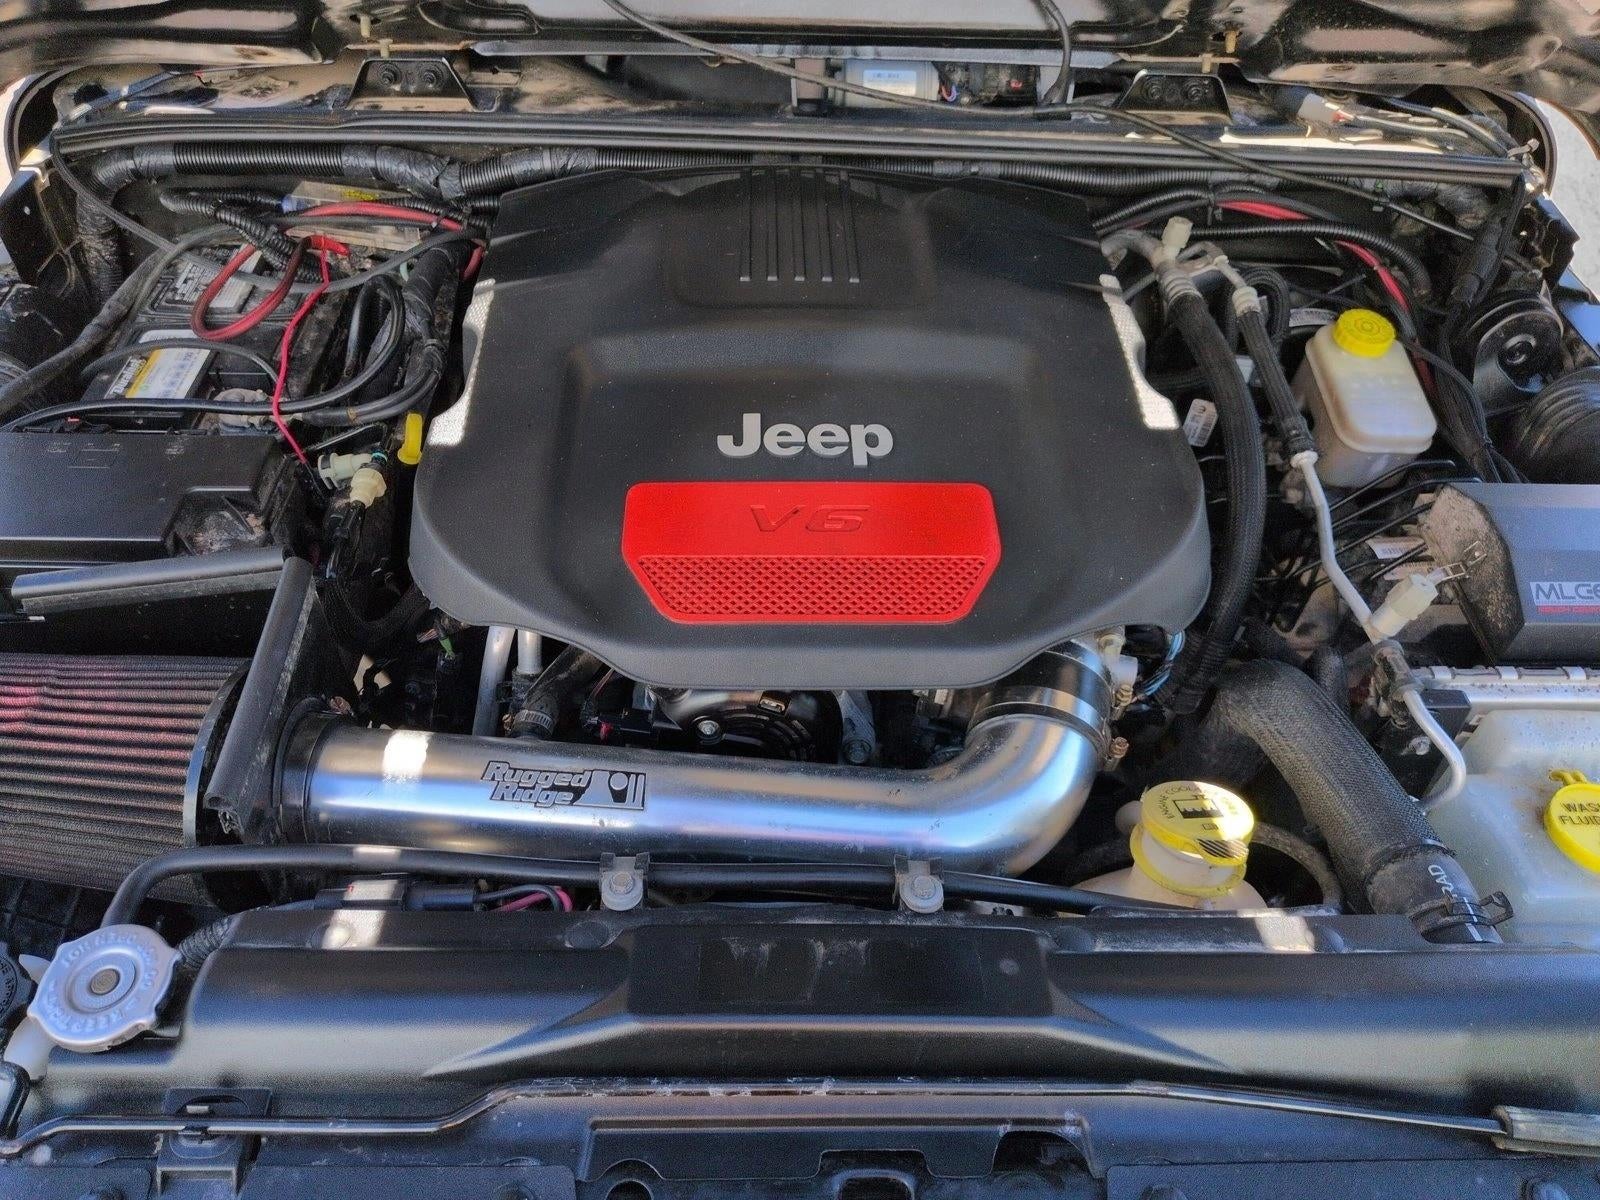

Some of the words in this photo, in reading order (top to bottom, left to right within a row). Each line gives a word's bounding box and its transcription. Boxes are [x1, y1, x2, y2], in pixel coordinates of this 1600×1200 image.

[717, 412, 894, 468] Jeep
[750, 504, 870, 532] V6
[482, 761, 592, 789] Rugged
[492, 780, 574, 808] Ridge
